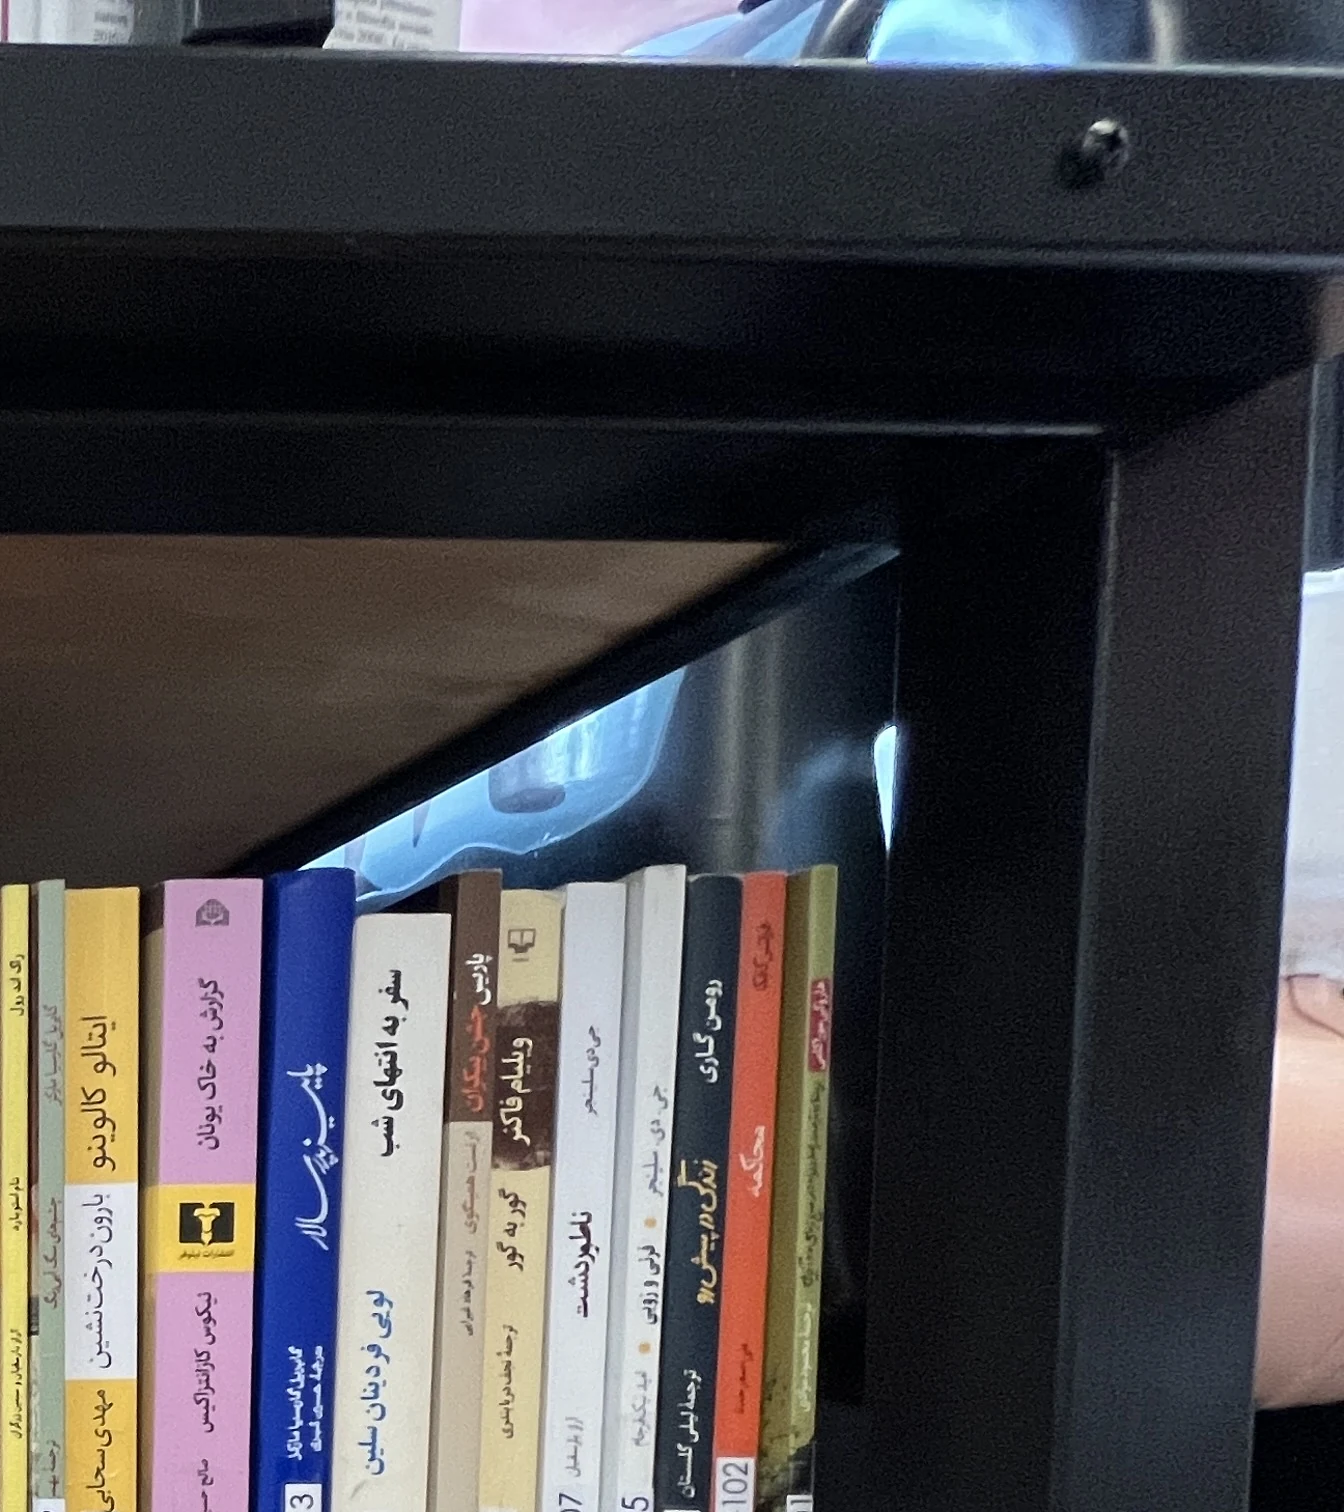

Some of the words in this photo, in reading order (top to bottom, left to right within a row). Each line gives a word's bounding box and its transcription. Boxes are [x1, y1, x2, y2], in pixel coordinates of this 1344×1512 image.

[197, 978, 224, 1031] گزارش
[378, 970, 409, 1011] سفر
[699, 979, 722, 1030] رومن
[82, 1015, 116, 1076] ایتالو
[206, 1035, 224, 1054] به
[382, 1016, 406, 1036] به
[198, 1060, 218, 1100] خاک
[372, 1043, 404, 1111] انتهای
[501, 1037, 532, 1093] ویلیام
[693, 1034, 720, 1083] گاری
[82, 1087, 116, 1172] کالوینو
[197, 1105, 224, 1151] یونان
[371, 1116, 401, 1157] شب
[498, 1098, 532, 1147] فاکنر
[739, 1125, 766, 1197] محاکمه
[498, 1189, 526, 1216] گور
[505, 1222, 523, 1237] به
[499, 1243, 524, 1272] گور
